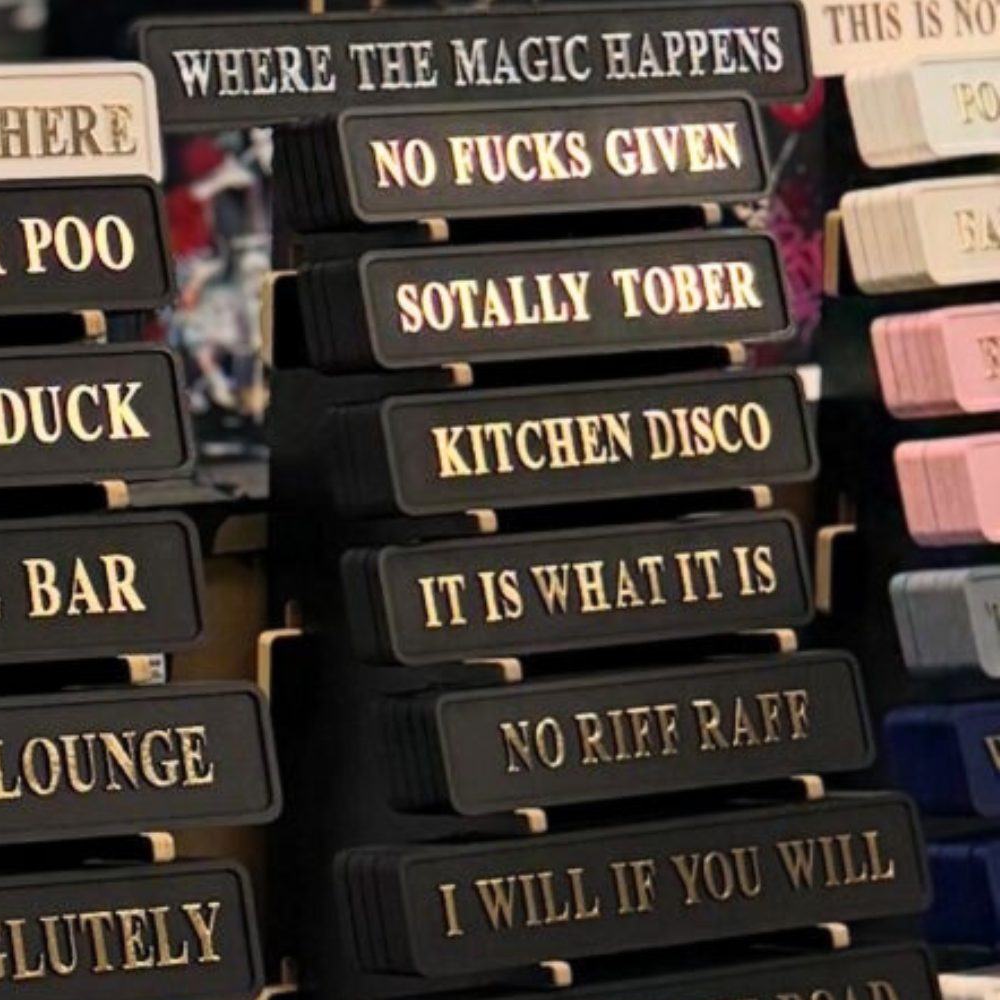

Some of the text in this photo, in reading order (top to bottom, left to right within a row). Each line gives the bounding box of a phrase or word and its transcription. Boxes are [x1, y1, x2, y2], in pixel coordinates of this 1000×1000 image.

[822, 0, 1000, 45] THIS IS NO
[172, 26, 784, 97] WHERE THE MAGIC HAPPENS
[370, 122, 742, 188] NO FUCKS GIVEN
[19, 214, 136, 274] POO
[397, 261, 762, 333] SOTALLY TOBER
[432, 401, 772, 478] KITCHEN DISCO
[22, 553, 146, 619] BAR
[418, 545, 777, 628] IT IS WHAT IT IS
[500, 689, 811, 773] NO RIFF RAFF
[439, 830, 896, 938] I WILL IF YOU WILL
